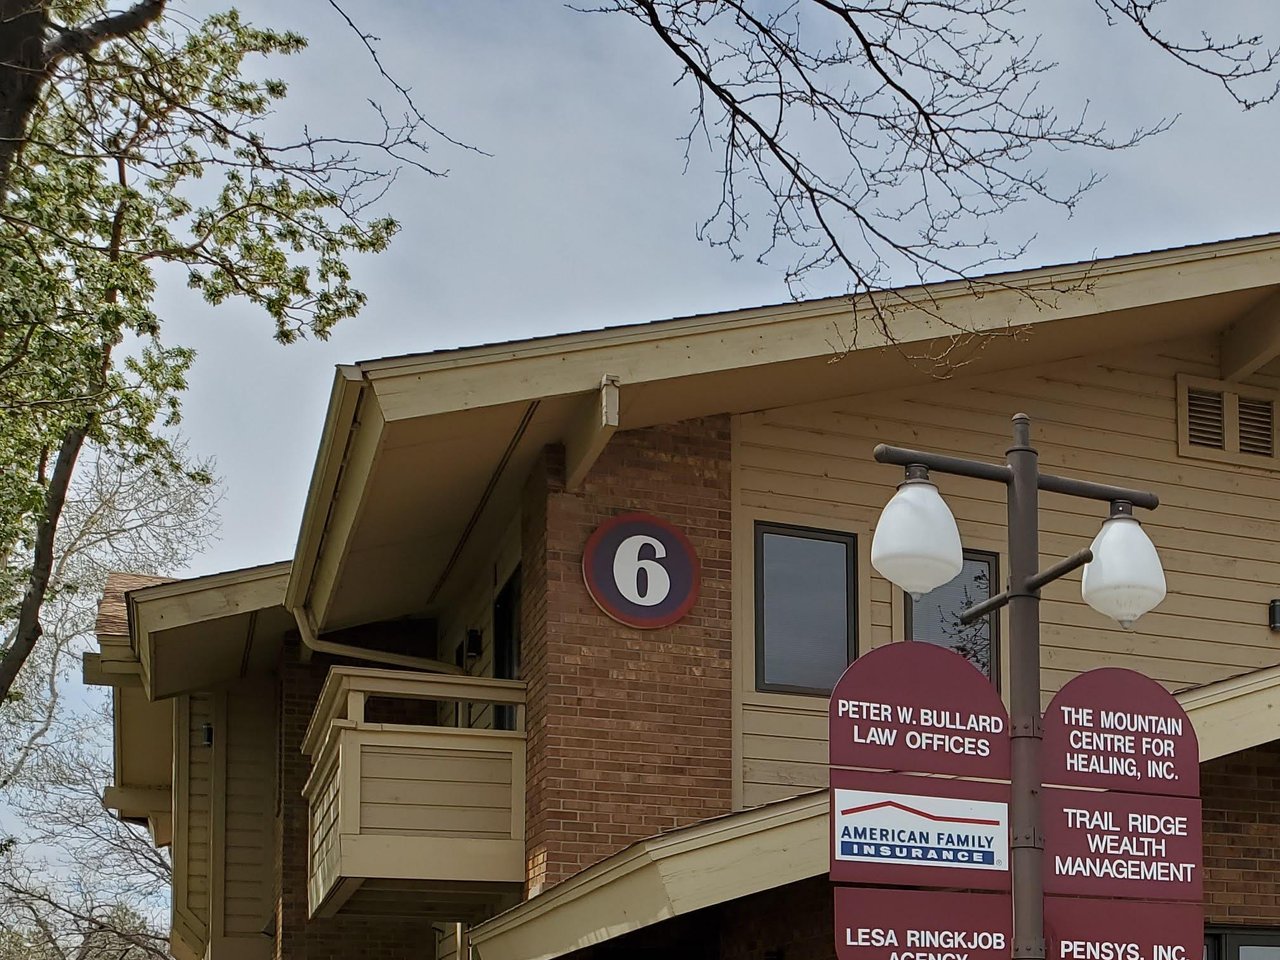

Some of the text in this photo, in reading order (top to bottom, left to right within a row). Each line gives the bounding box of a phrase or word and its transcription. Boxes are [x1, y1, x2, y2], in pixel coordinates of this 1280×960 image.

[612, 533, 671, 607] 6
[838, 699, 1003, 734] PETER W. BULLARD
[1060, 706, 1183, 736] THE MOUNTAIN
[853, 725, 990, 757] LAW OFFICES
[1069, 730, 1175, 757] CENTRE FOR
[1066, 752, 1179, 780] HEALING, INC.
[1063, 808, 1187, 836] TRAIL RIDGE
[841, 825, 994, 849] AMERICAN FAMILY
[1087, 833, 1166, 857] WEALTH
[852, 844, 984, 862] INSURANCE
[1055, 855, 1195, 882] MANAGEMENT
[846, 928, 1005, 950] LESA RINGKJOB
